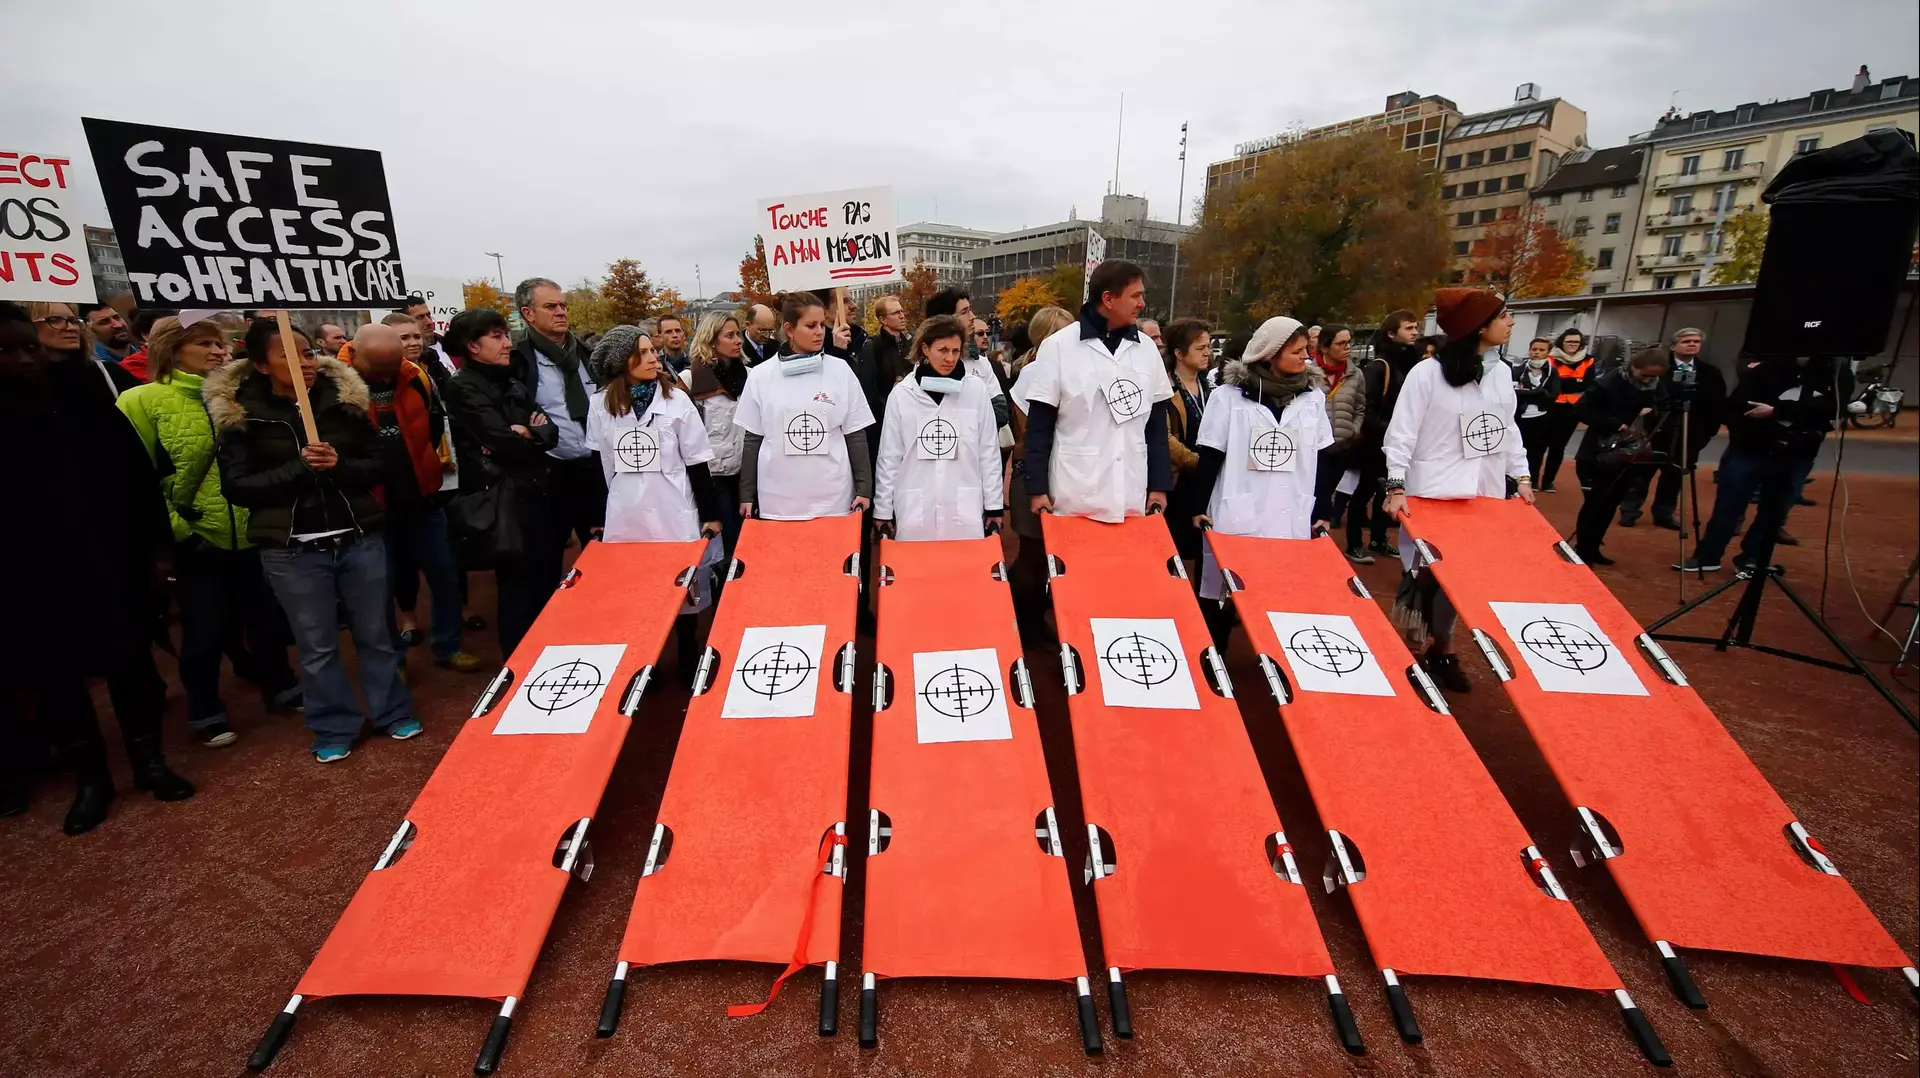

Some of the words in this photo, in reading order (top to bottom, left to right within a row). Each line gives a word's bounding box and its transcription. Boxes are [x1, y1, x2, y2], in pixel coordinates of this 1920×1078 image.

[124, 140, 340, 209] SAFE
[0, 197, 71, 242] OS
[137, 205, 391, 259] ACCESS
[767, 203, 828, 231] TOUCHE
[842, 201, 871, 226] PAS
[826, 231, 891, 265] MÉDECIN
[406, 289, 435, 300] OP
[1804, 320, 1822, 328] RCF
